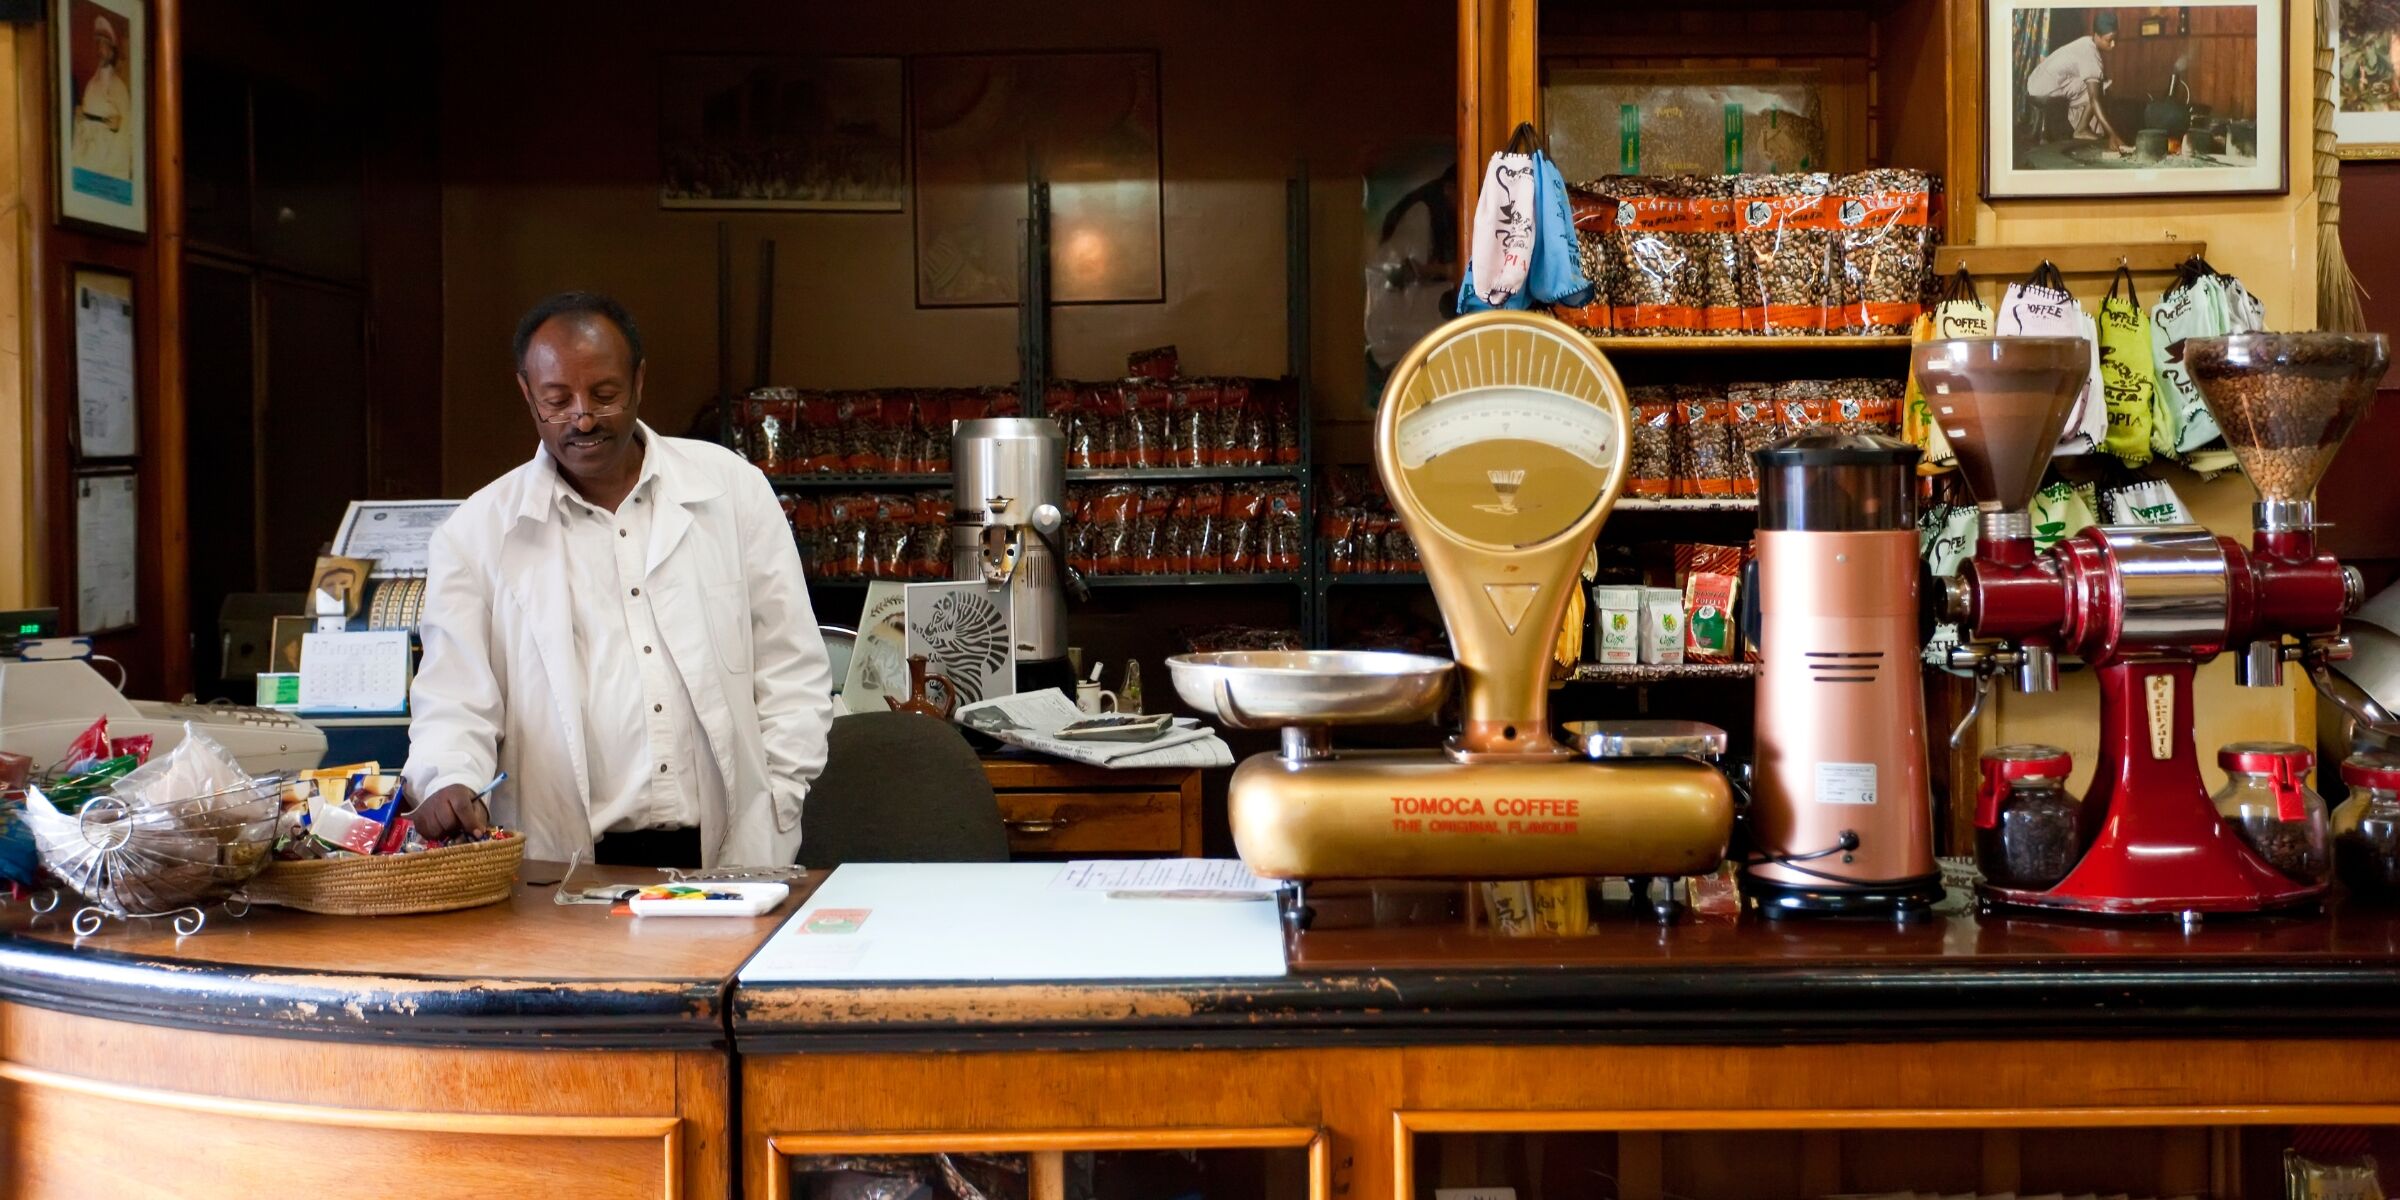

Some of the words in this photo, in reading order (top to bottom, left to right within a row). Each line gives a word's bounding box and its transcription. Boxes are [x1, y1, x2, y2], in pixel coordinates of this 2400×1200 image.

[2130, 503, 2177, 520] COFFEE
[1390, 797, 1486, 816] TOMOCA
[1494, 797, 1580, 817] COFFEE
[1392, 819, 1422, 833] THE
[1429, 820, 1499, 834] ORIGINAL
[1507, 820, 1578, 834] FLAVOUR
